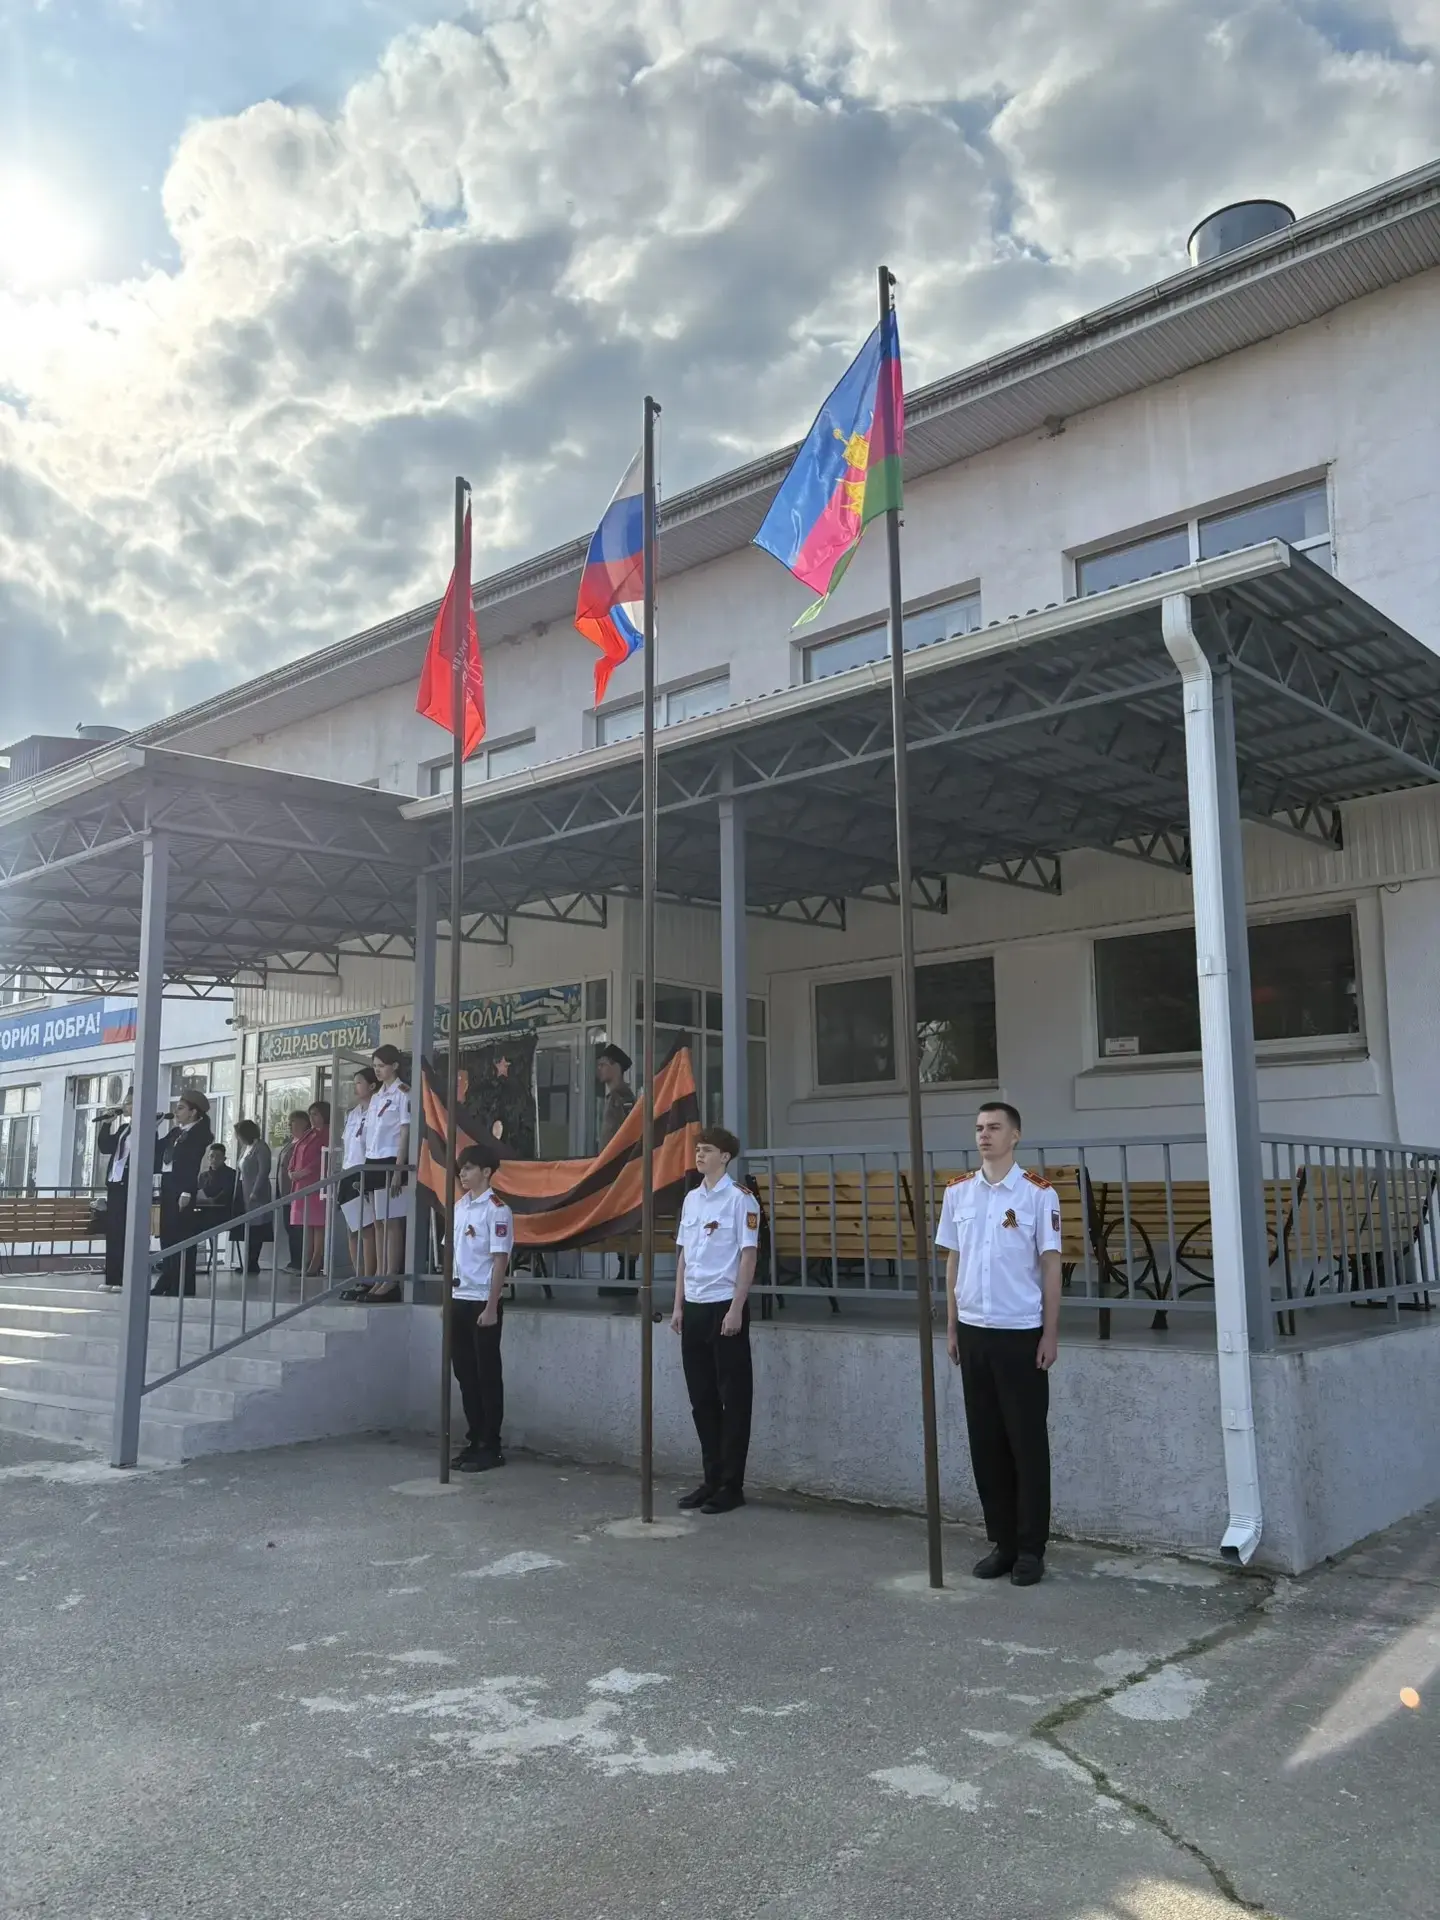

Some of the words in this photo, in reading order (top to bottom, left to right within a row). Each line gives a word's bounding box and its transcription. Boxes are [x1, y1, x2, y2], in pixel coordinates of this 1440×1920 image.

[0, 1023, 40, 1050] ОРИЯ
[43, 1012, 101, 1047] ДОБРА!
[273, 1020, 372, 1056] ЗДРАВСТВУЙ,
